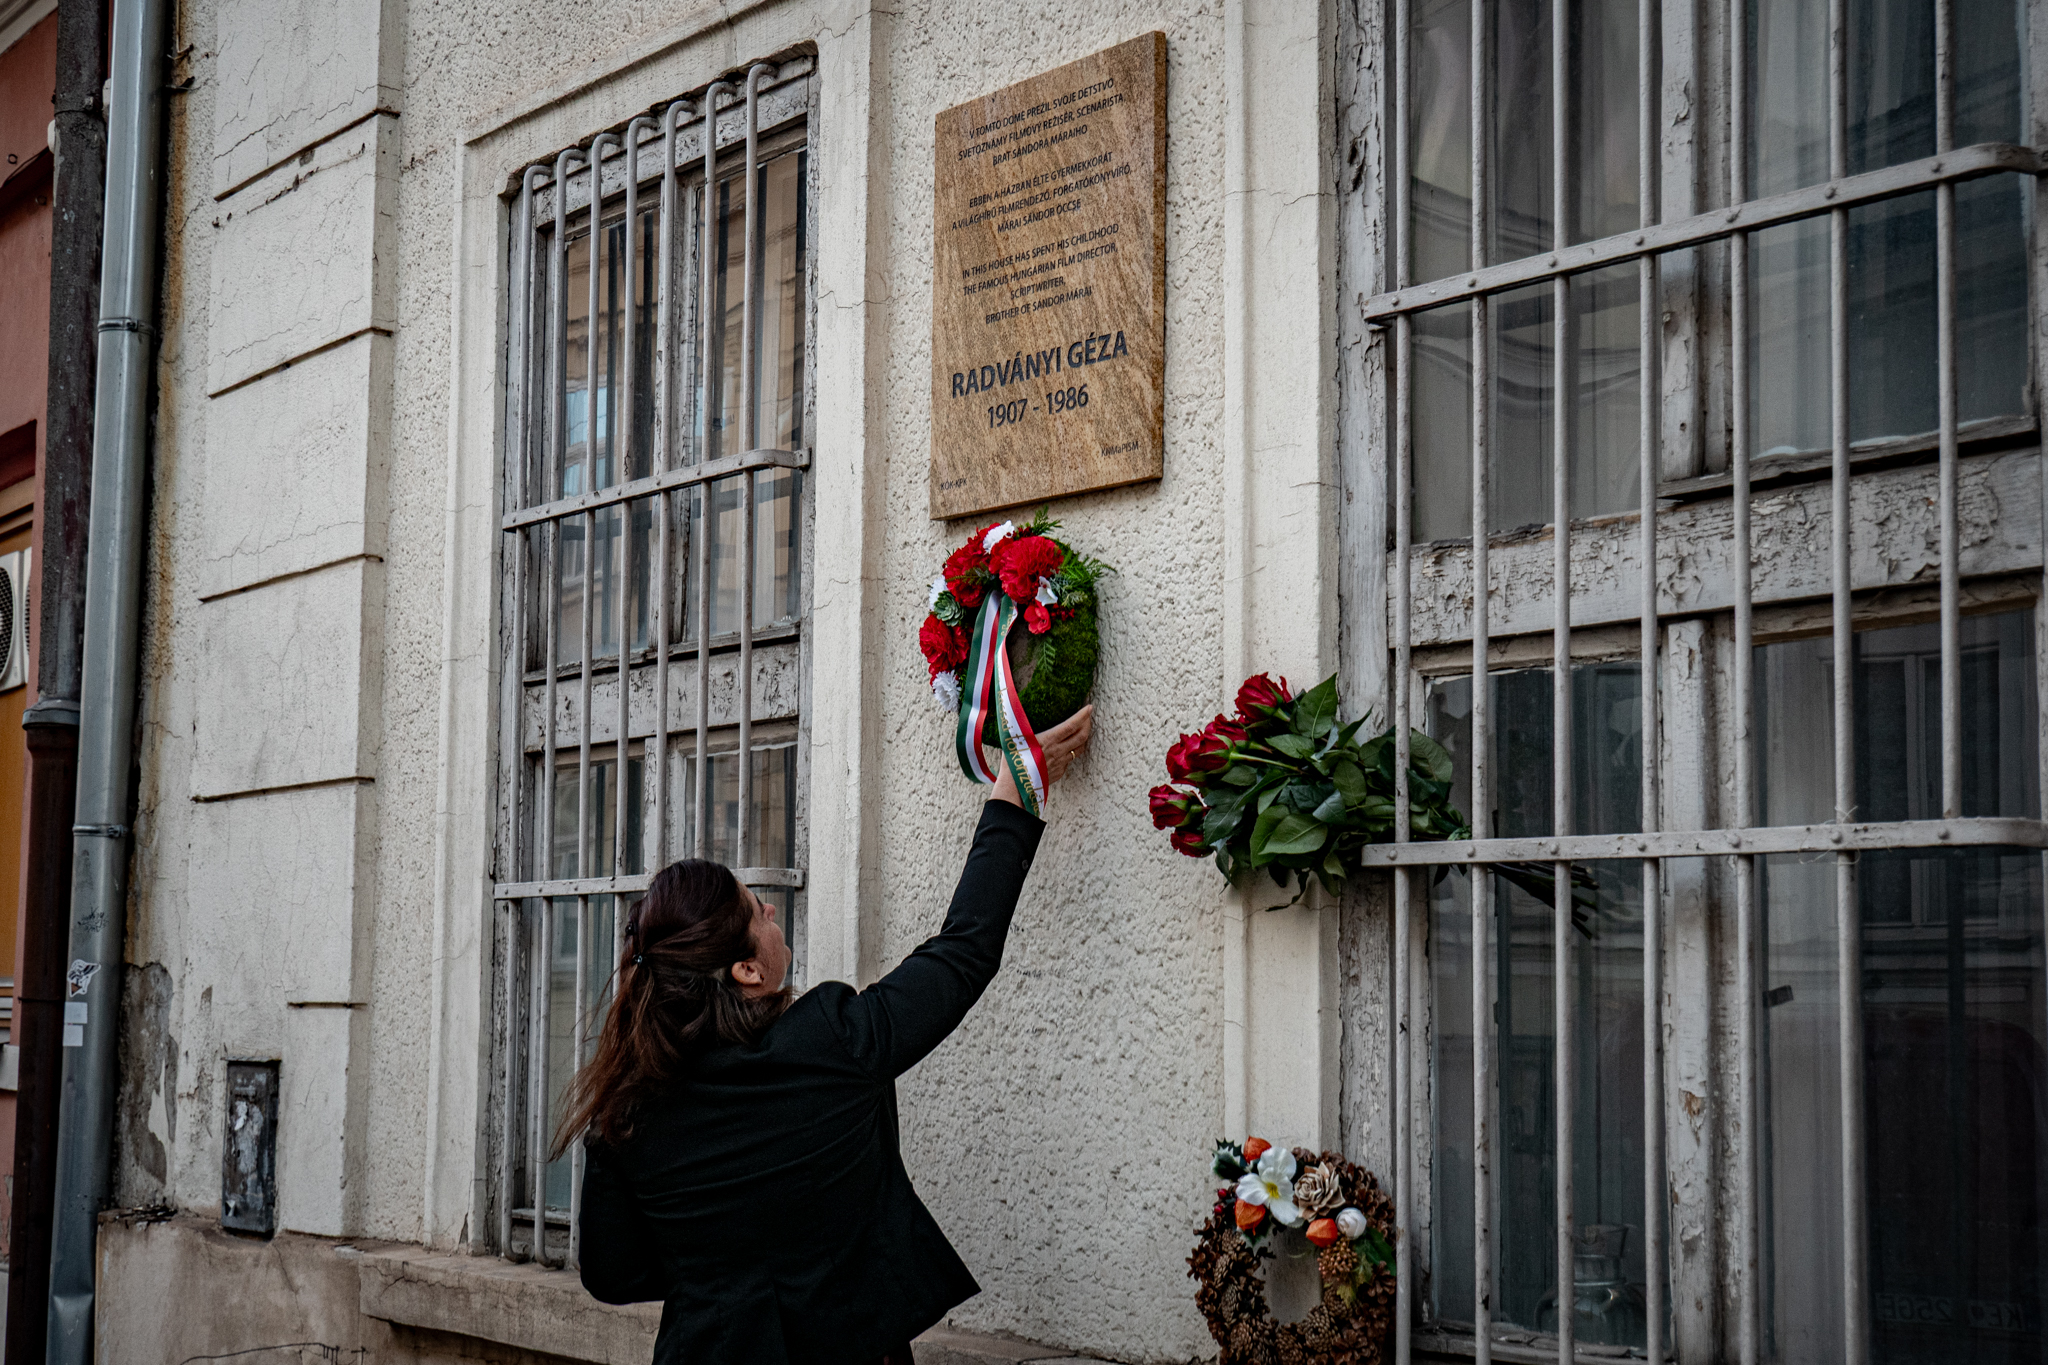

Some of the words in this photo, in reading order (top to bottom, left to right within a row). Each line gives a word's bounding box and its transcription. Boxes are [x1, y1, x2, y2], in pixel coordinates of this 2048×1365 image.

[969, 130, 976, 139] V
[976, 121, 1002, 138] TOMTO
[1003, 113, 1026, 129] DOME
[1026, 102, 1051, 122] PREŽIL
[1053, 92, 1077, 108] SVOJE
[1078, 77, 1114, 101] DETSTVO
[992, 152, 1011, 167] BRAT
[1012, 138, 1049, 159] SÁNDORA
[1050, 124, 1088, 145] MÁRAIHO
[1009, 122, 1042, 145] FILMOVÝ
[969, 192, 992, 208] EBBEN
[993, 189, 1000, 199] A
[1000, 178, 1032, 198] HÁZBAN
[1033, 172, 1050, 187] ÉLTE
[1050, 151, 1113, 181] GYERMEKKORÁT
[951, 221, 958, 231] A
[997, 218, 1022, 235] MÁRAI
[1023, 206, 1055, 226] SÁNDOR
[962, 268, 971, 280] IN
[971, 261, 987, 277] THIS
[988, 252, 1014, 271] HOUSE
[1015, 248, 1031, 263] HAS
[1032, 242, 1056, 259] SPENT
[1057, 237, 1069, 250] HIS
[1070, 223, 1119, 247] CHILDHOOD
[963, 283, 977, 296] THE
[978, 274, 1009, 293] FAMOUS
[1010, 260, 1056, 284] HUNGARIAN
[1057, 254, 1076, 269] FILM
[1077, 242, 1118, 263] DIRECTOR,
[985, 304, 1019, 325] BROTHER
[1020, 301, 1032, 314] OF
[1032, 290, 1065, 312] SÁNDOR
[1066, 285, 1092, 303] MÁRAI
[1010, 275, 1066, 300] SCRIPTWRITER,
[952, 346, 1061, 399] RADVÁNYI
[1067, 331, 1128, 368] GÉZA
[987, 398, 1028, 428] 1907
[1045, 383, 1089, 415] 1986
